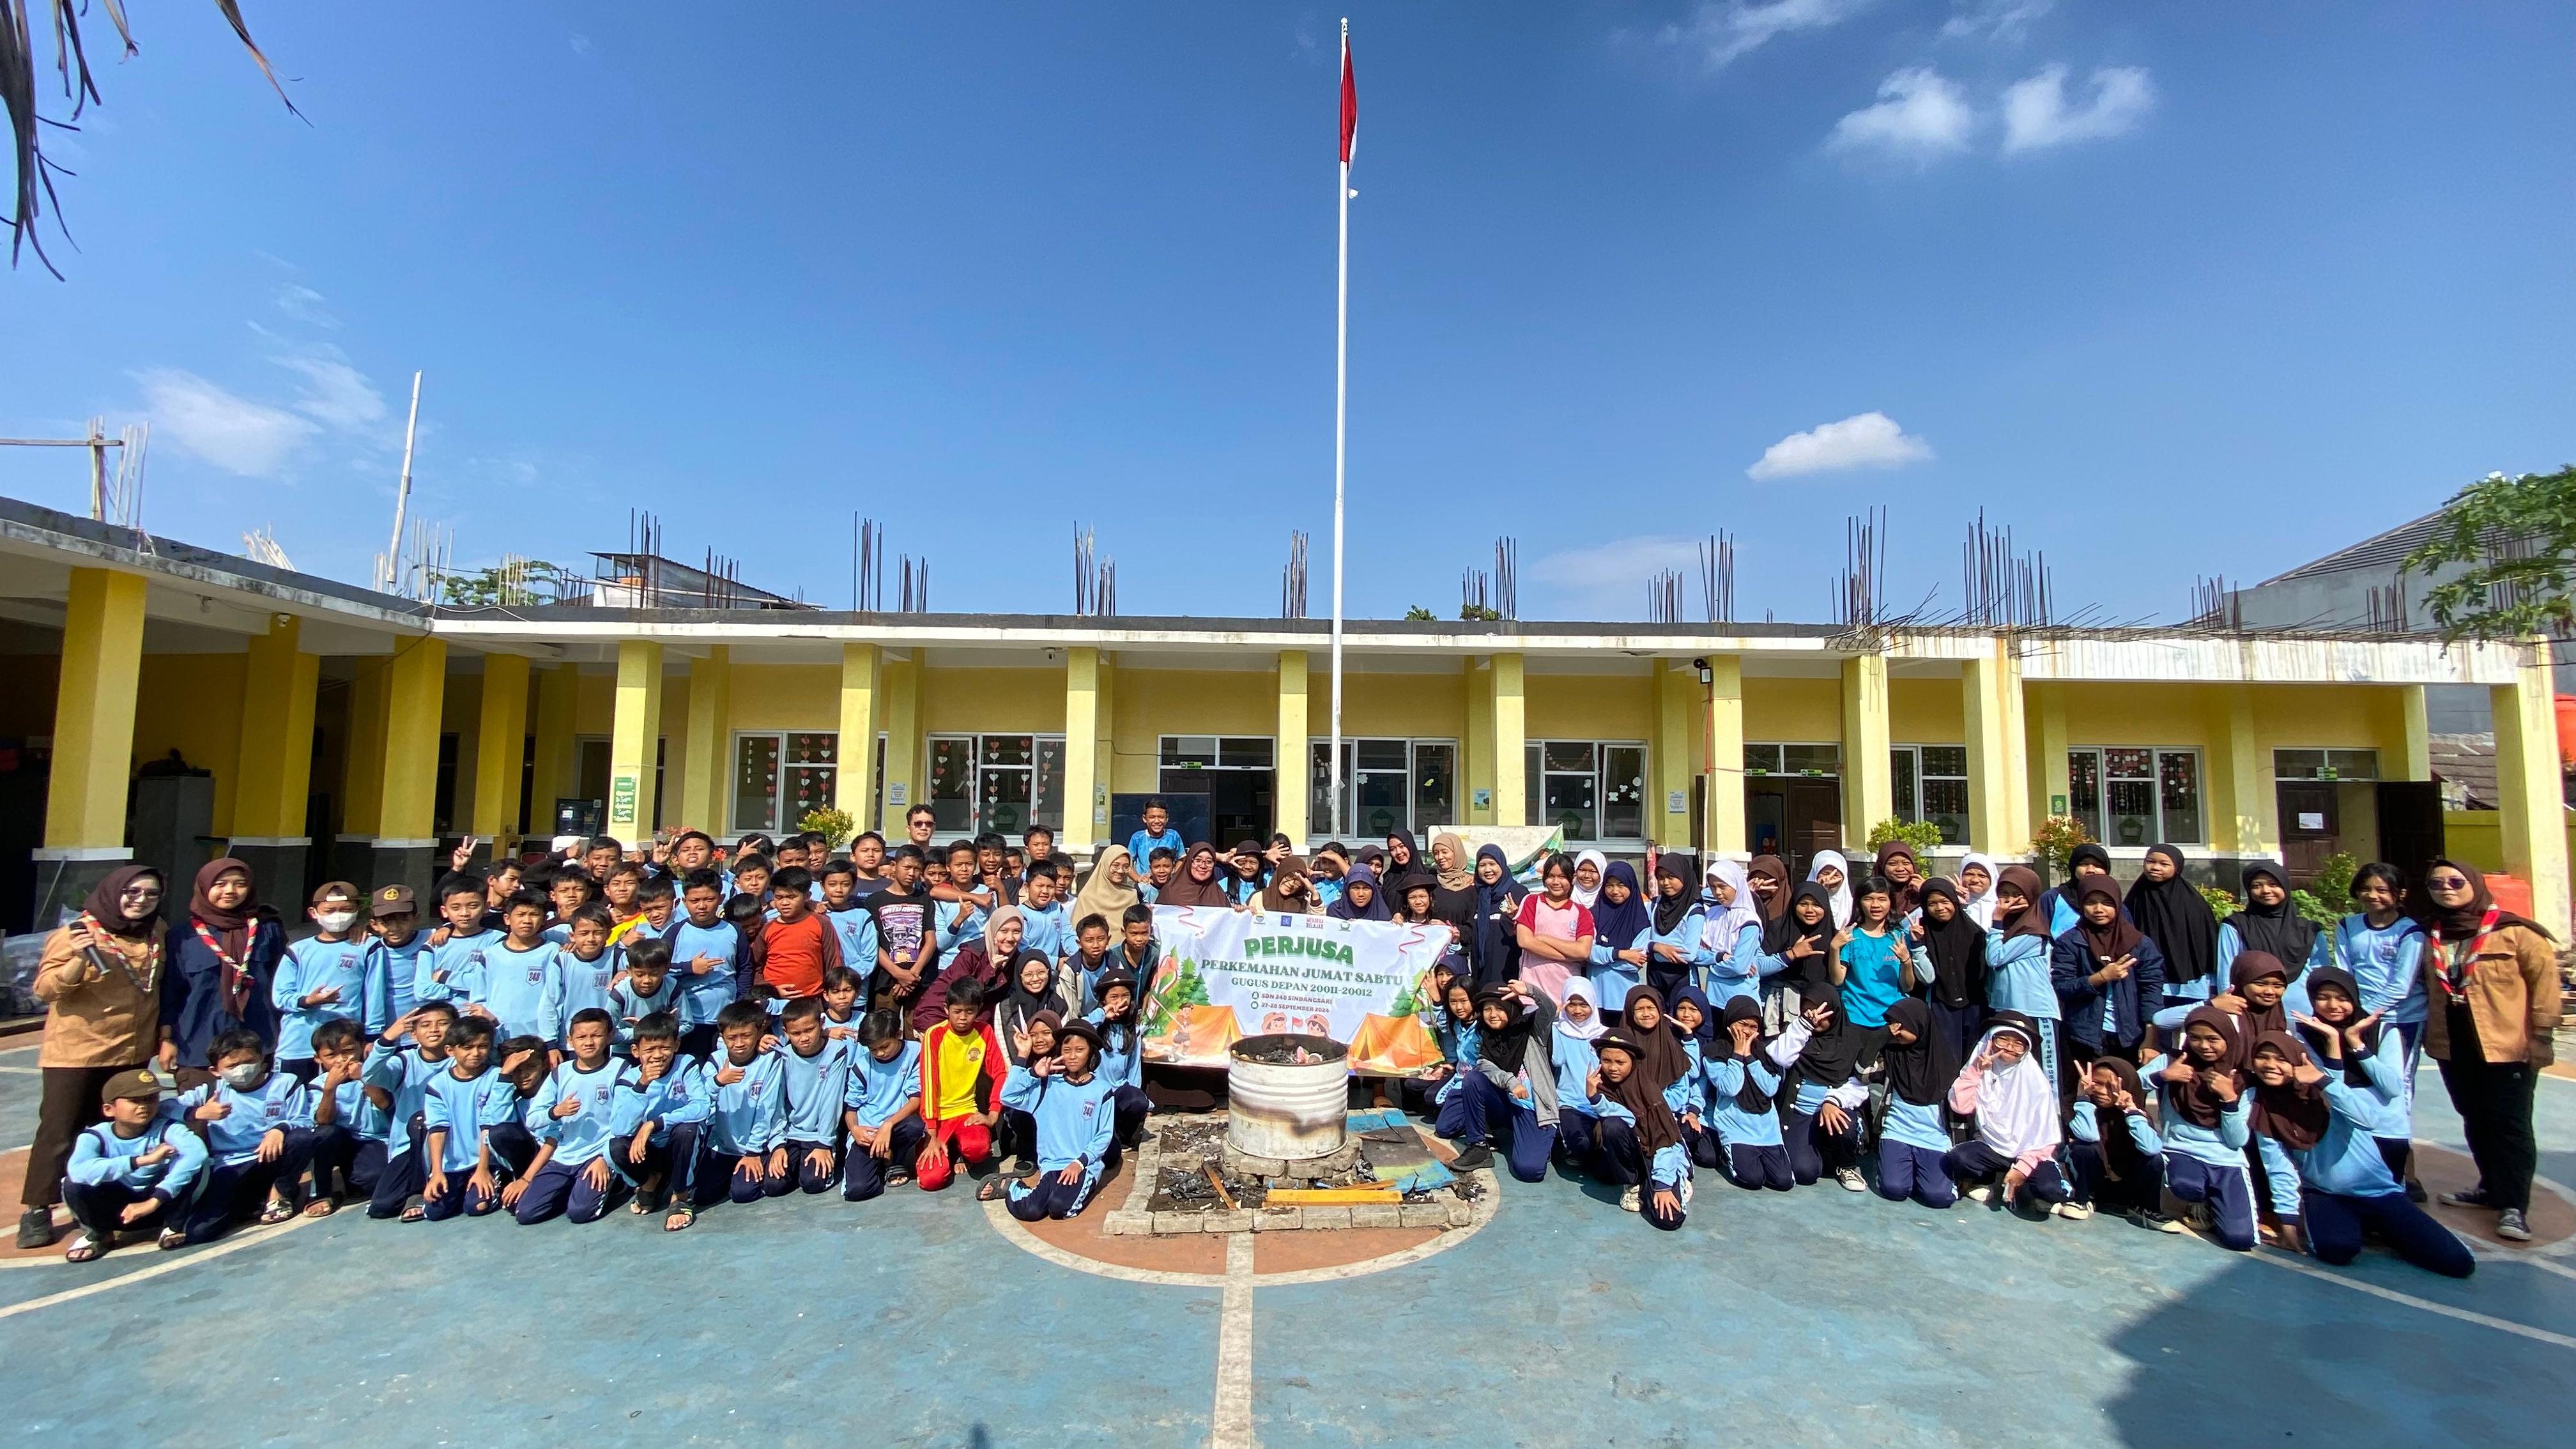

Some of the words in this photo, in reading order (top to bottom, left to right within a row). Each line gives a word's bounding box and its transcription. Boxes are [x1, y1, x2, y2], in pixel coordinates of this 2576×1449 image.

[1244, 936, 1354, 966] PERJUSA
[339, 958, 353, 969] 248
[528, 972, 541, 981] 248
[1201, 959, 1300, 976] PERKEMAHAN
[1301, 968, 1353, 981] JUMAT
[1355, 972, 1403, 986] SABTU
[1232, 977, 1269, 988] GUGUS
[1271, 981, 1308, 992] DEPAN
[1310, 984, 1373, 997] 20011-20012
[1287, 994, 1333, 1004] SINDANGSARI
[1278, 1003, 1314, 1011] SEPTEMBER
[266, 1107, 280, 1117] 248
